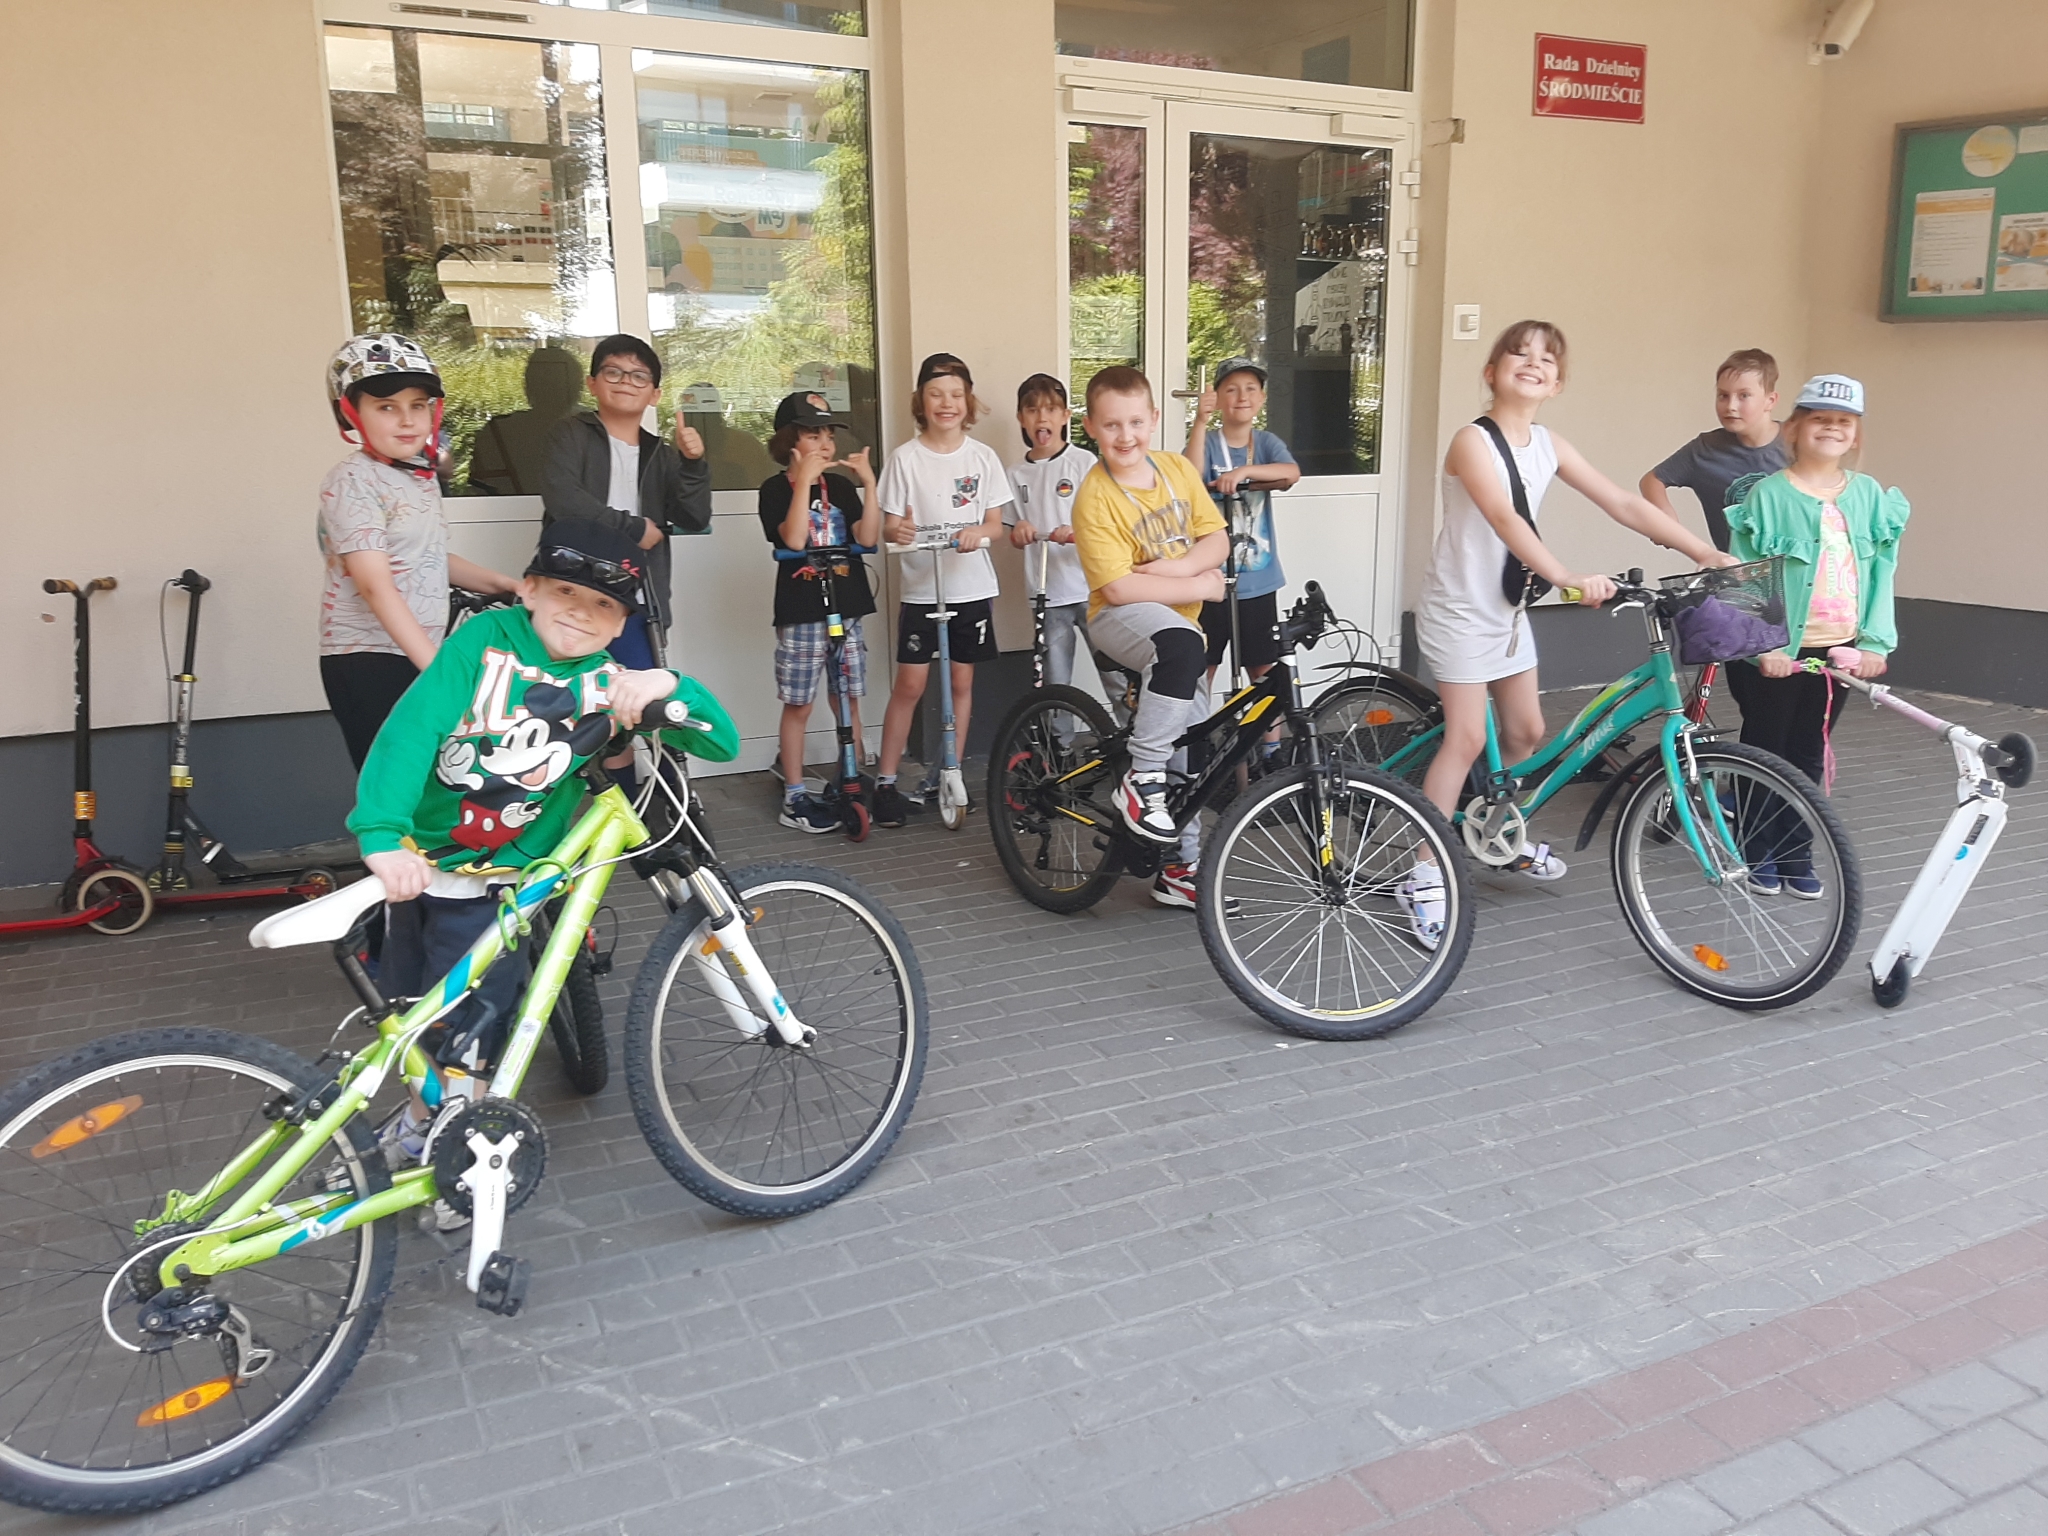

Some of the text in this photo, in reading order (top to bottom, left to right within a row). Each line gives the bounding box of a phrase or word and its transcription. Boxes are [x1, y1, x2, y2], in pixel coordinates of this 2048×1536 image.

[1544, 53, 1642, 82] Rada Dzielnicy
[1538, 76, 1643, 105] ŚRÓDMIEŚCIE
[1822, 382, 1851, 400] HI!
[937, 532, 948, 540] 21
